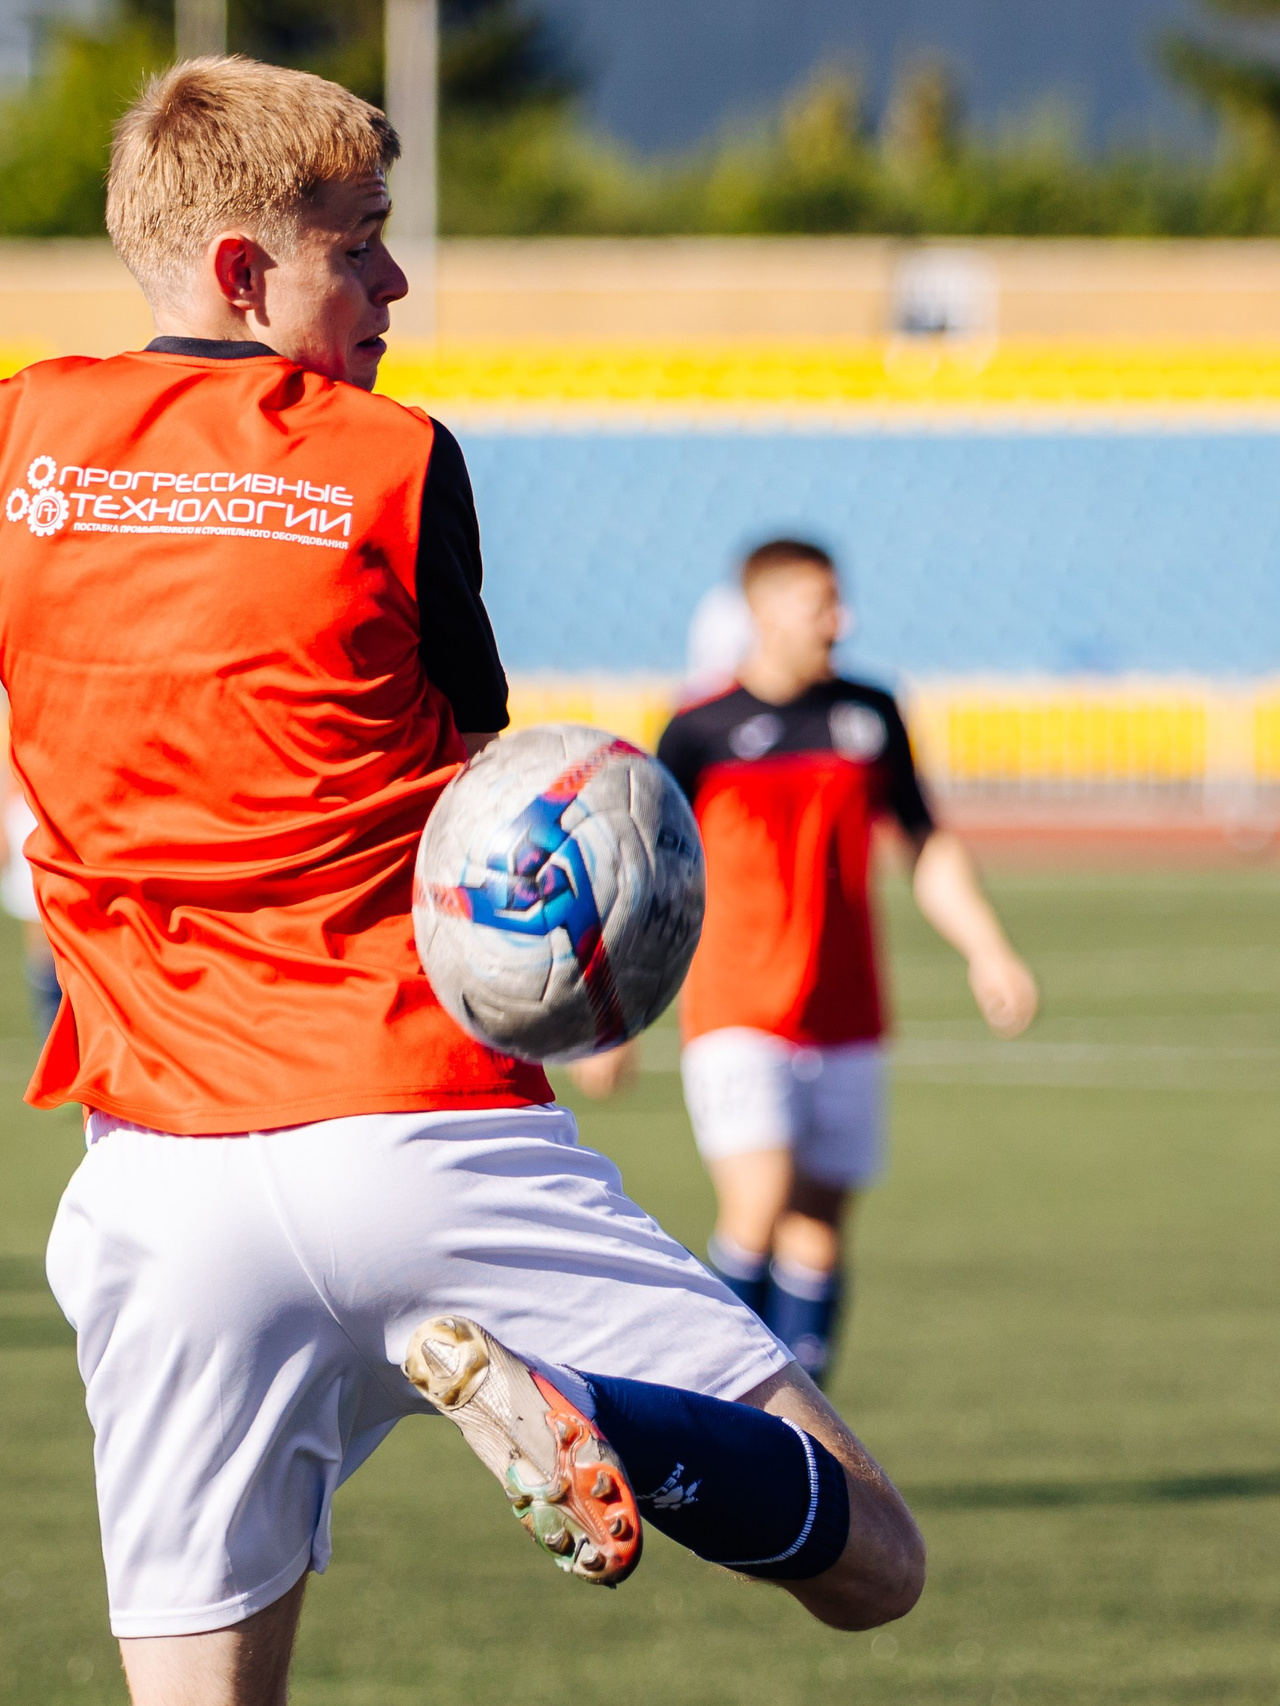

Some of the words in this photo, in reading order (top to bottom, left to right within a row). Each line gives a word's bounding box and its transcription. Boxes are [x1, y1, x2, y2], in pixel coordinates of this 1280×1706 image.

[59, 465, 354, 506] ПРОГРЕССИВНЫЕ
[70, 492, 352, 537] ТЕХНОЛОГИИ
[73, 522, 119, 533] ПОСТАВКА
[194, 527, 201, 535] И
[202, 526, 271, 538] СТРОИТЕЛЬНОГО
[272, 531, 349, 550] ОБОРУДОВАНИЯ
